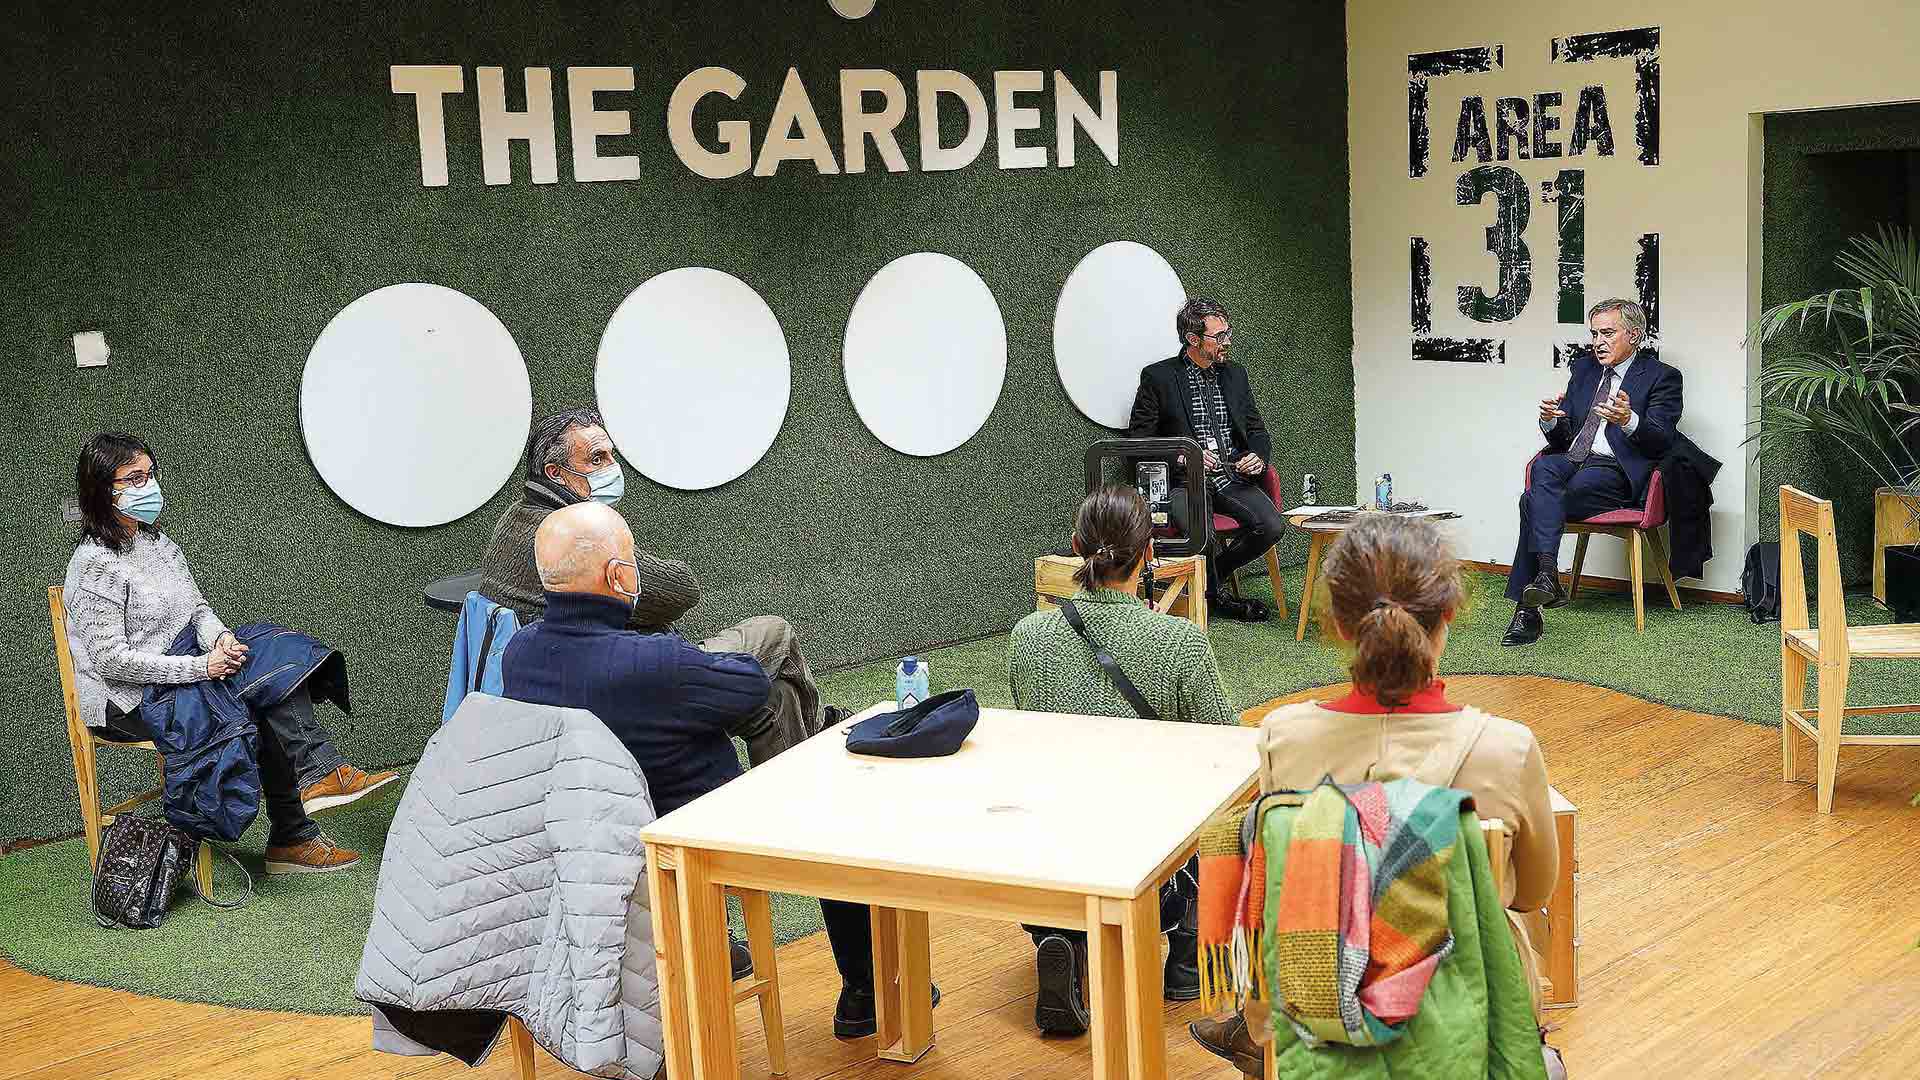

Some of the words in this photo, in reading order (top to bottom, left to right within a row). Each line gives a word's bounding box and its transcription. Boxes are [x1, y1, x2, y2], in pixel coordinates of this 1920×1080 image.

[390, 64, 641, 187] THE
[666, 65, 1119, 179] GARDEN
[1451, 83, 1615, 163] AREA
[1455, 164, 1585, 324] 31
